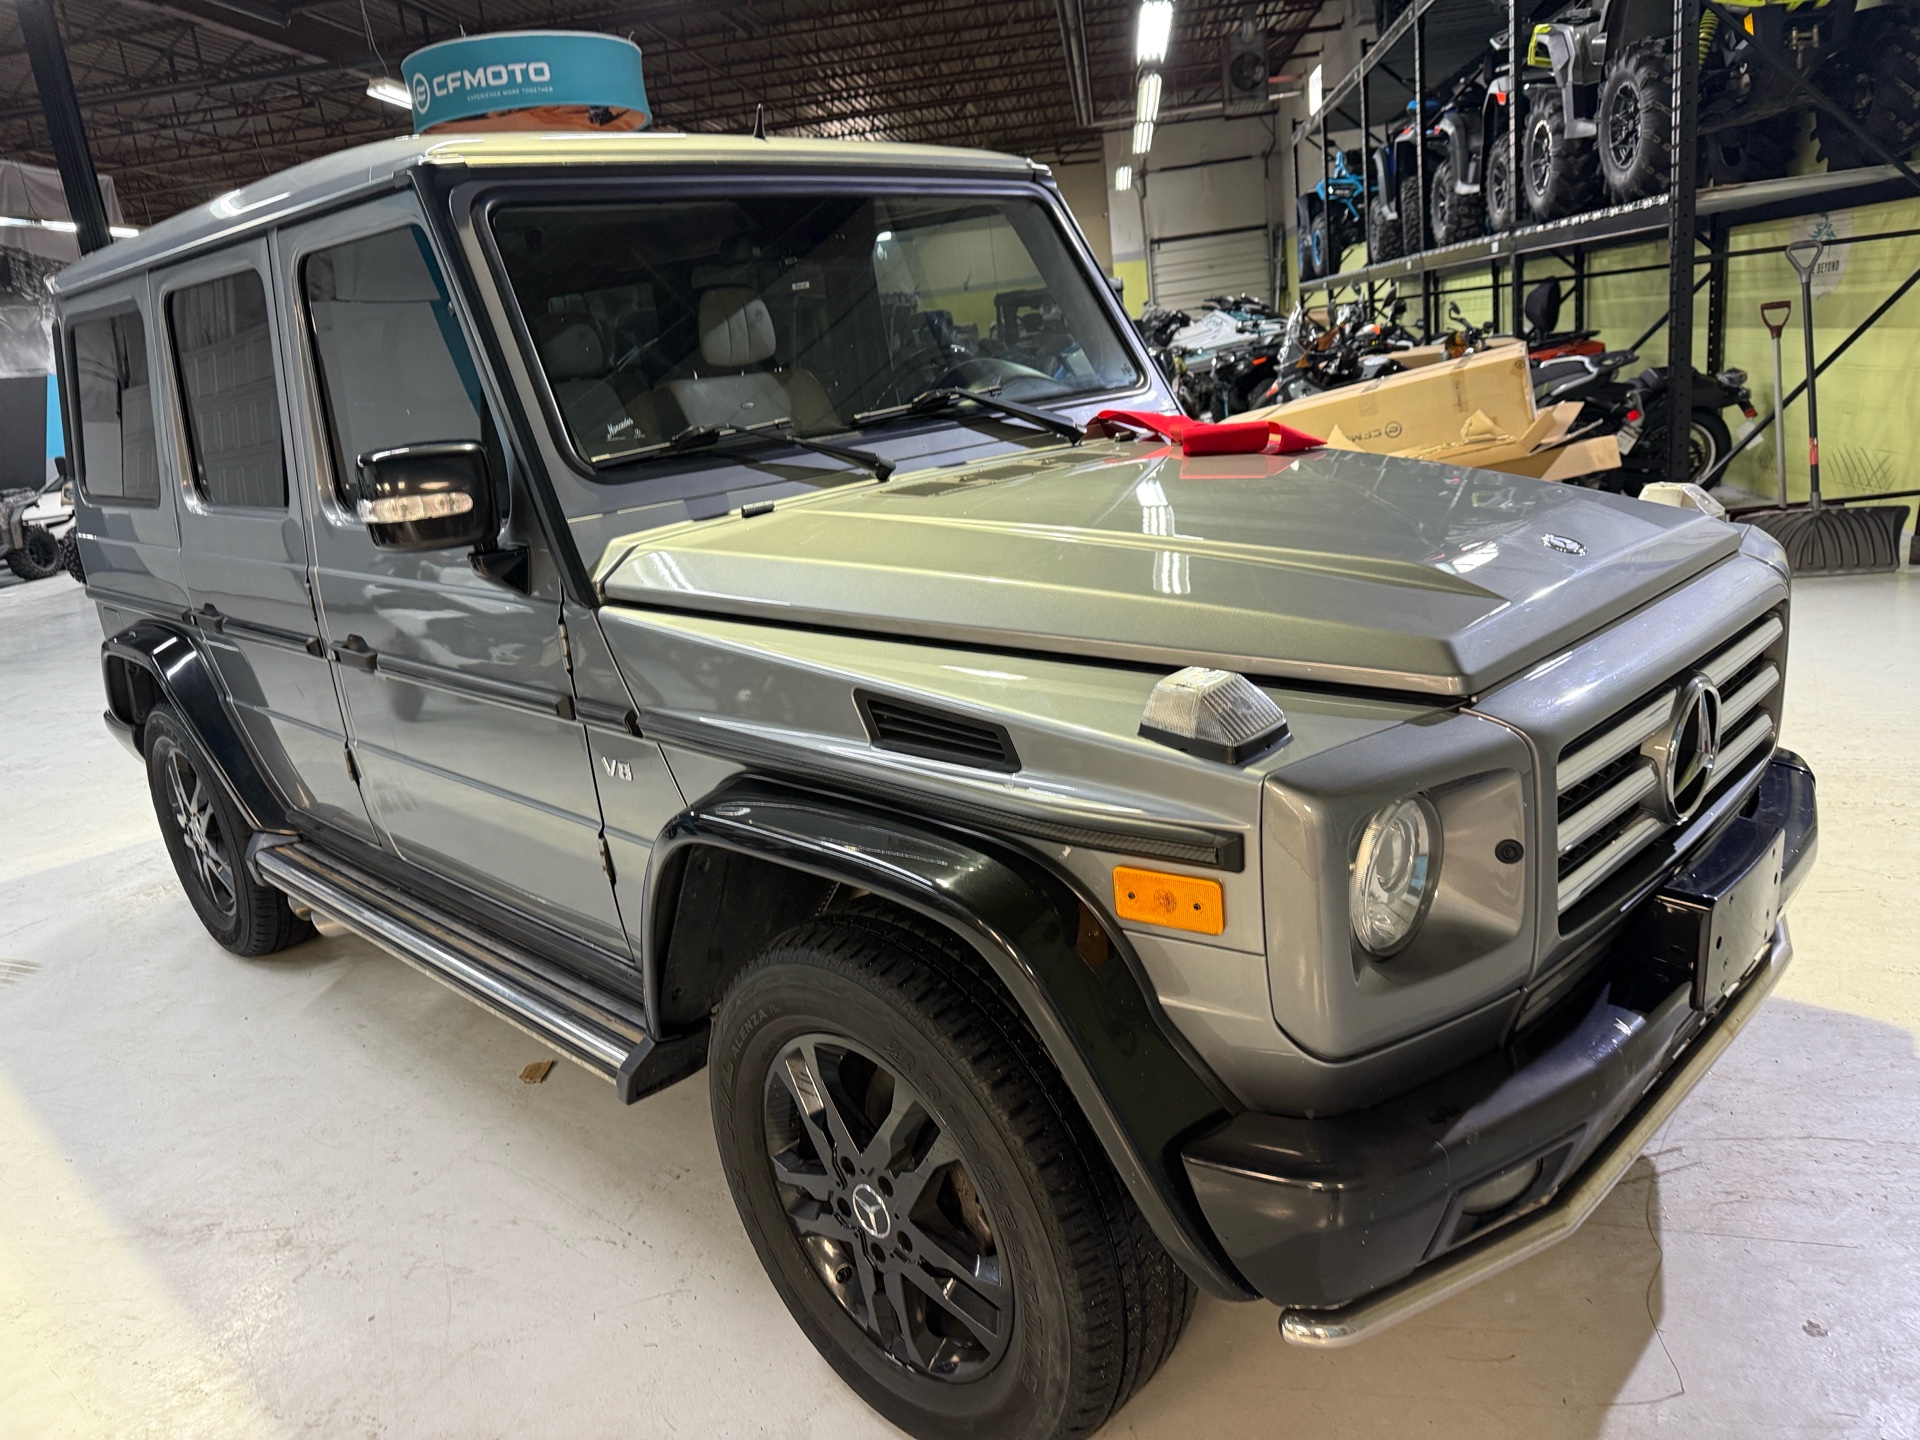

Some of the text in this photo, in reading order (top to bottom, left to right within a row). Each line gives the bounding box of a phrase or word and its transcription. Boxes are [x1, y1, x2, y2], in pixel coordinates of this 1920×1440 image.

[433, 62, 550, 97] CFMOTO
[467, 86, 554, 101] EXPERIENCE MORE TOGETHER
[601, 756, 633, 782] V8
[731, 1009, 768, 1059] ALENZA
